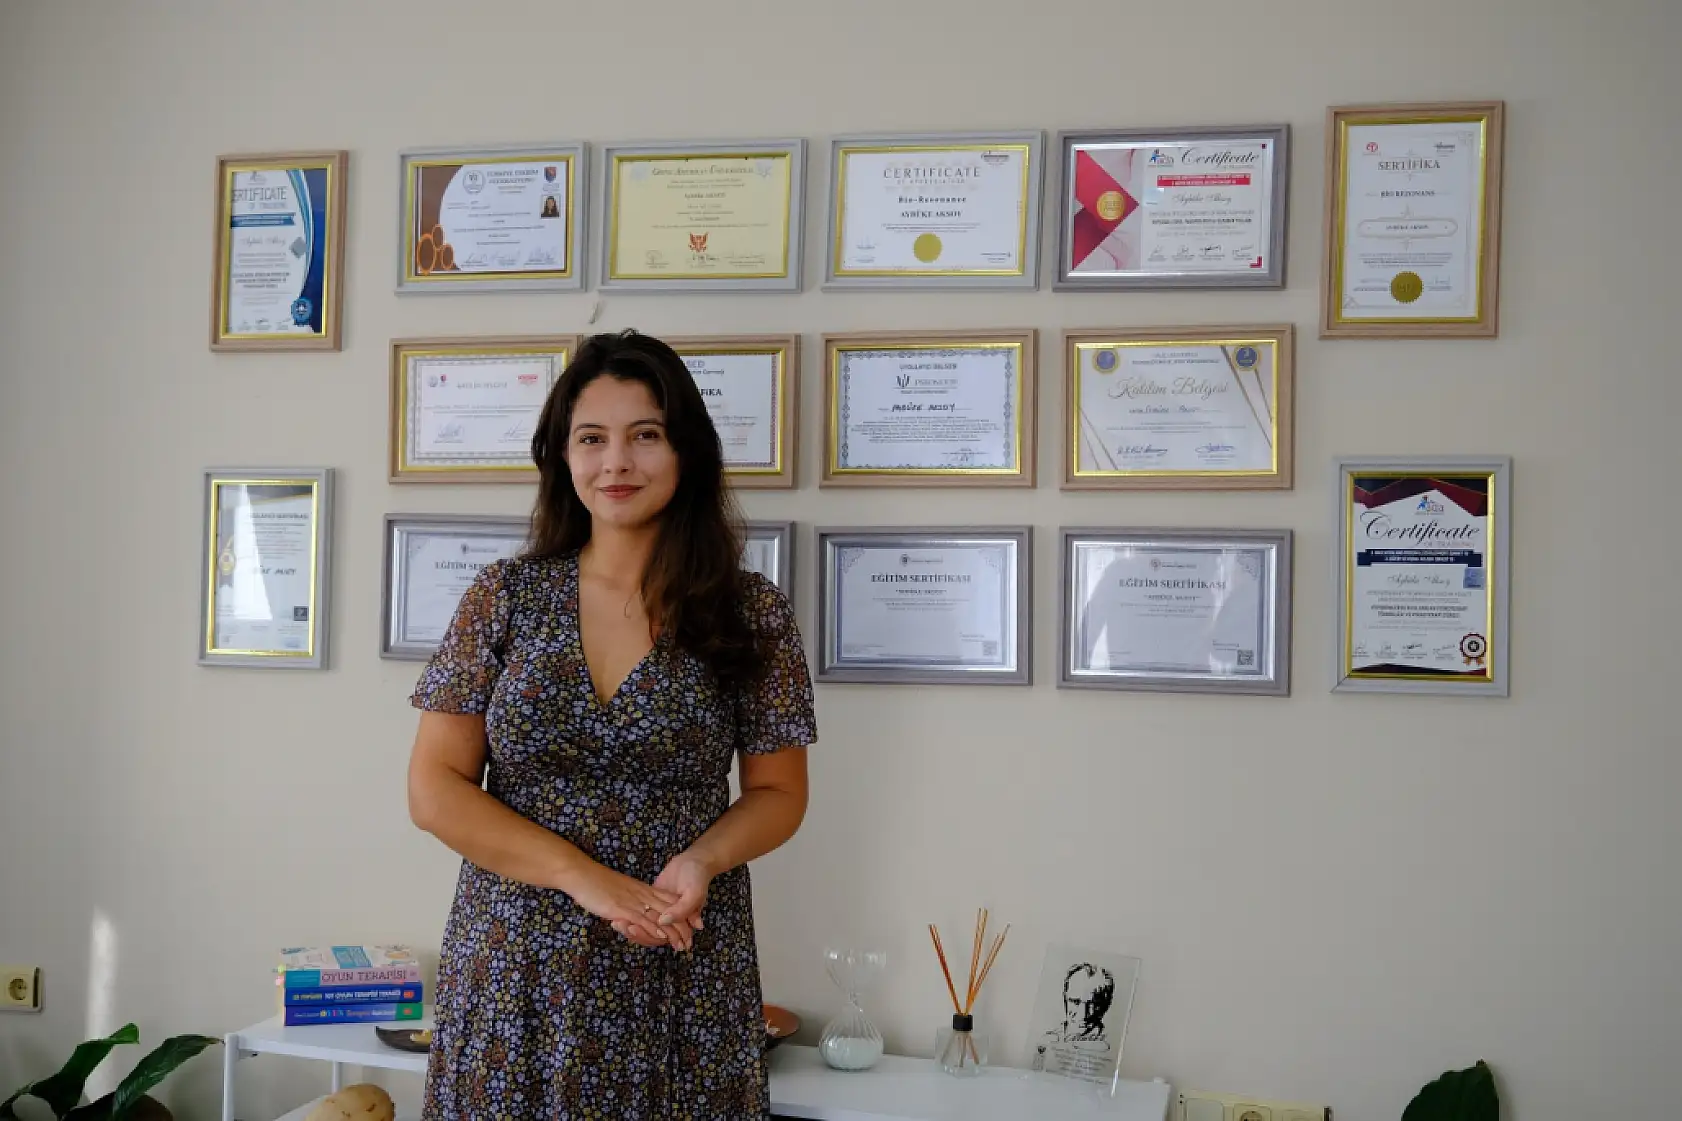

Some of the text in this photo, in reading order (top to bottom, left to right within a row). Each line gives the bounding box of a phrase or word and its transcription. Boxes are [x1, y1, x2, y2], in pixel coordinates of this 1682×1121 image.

[884, 167, 981, 179] CERTIFICATE
[1360, 511, 1480, 548] Certificate
[871, 572, 908, 583] EĞİTİM
[322, 971, 353, 982] OYUN
